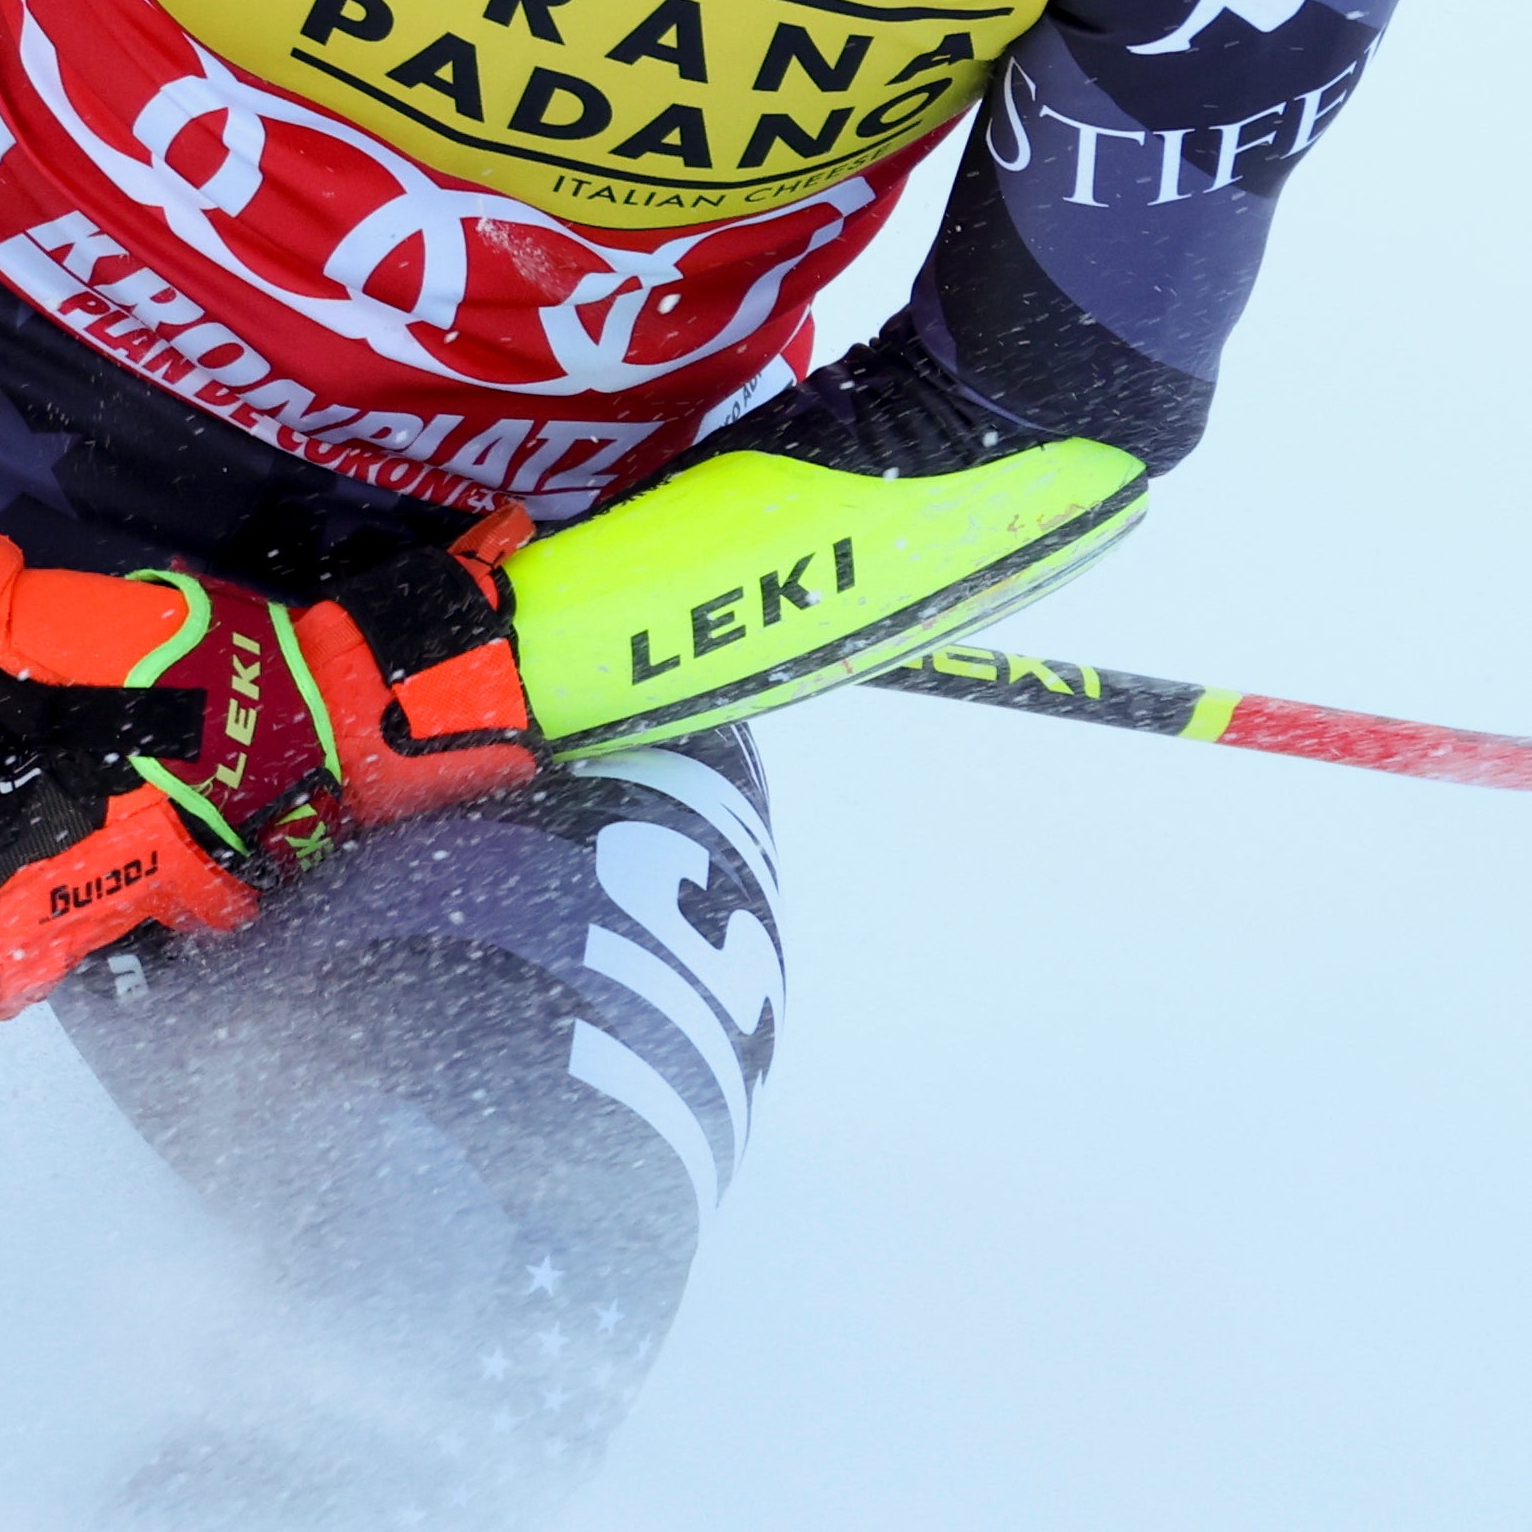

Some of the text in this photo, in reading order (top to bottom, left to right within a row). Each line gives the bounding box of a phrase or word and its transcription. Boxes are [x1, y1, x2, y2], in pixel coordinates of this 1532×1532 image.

[552, 142, 896, 209] ITALIAN CHEESE
[984, 35, 1382, 209] STIFE
[25, 209, 667, 493] KRONPLATZ
[57, 290, 197, 385] PLAN
[192, 377, 268, 428] DE
[629, 536, 857, 687] LEKI
[900, 643, 1102, 700] EKI
[216, 631, 262, 790] LEKI
[49, 850, 159, 919] racing
